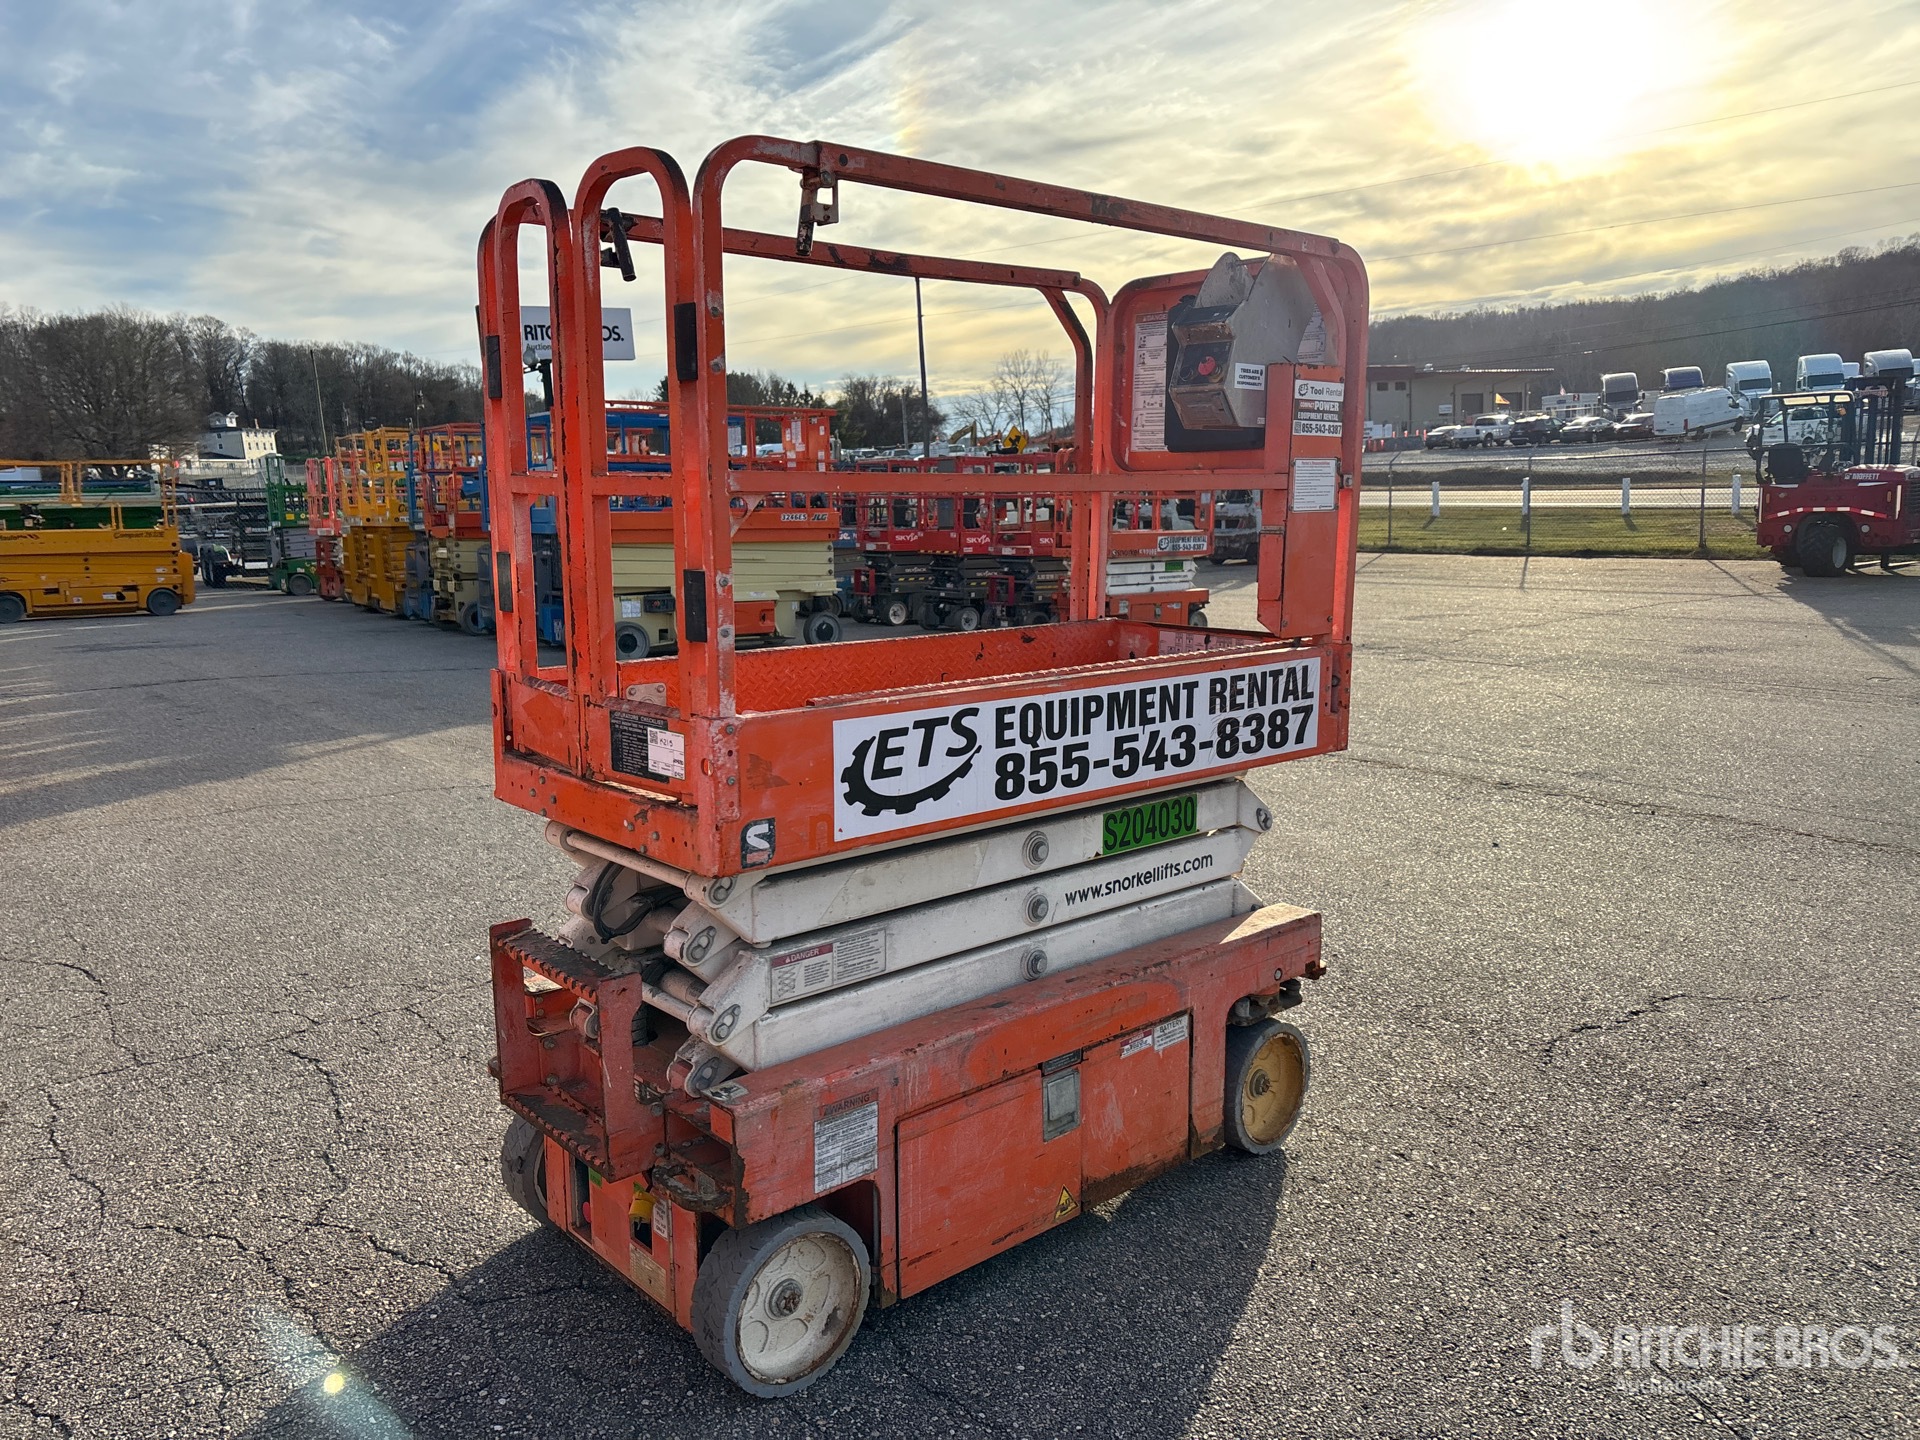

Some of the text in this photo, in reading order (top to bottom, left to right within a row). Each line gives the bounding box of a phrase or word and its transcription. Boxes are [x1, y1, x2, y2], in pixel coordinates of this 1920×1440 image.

[523, 324, 624, 341] RITC OS.
[526, 343, 551, 352] Auction
[1310, 386, 1342, 397] Tool Rental
[1314, 401, 1339, 411] POWER
[1297, 412, 1339, 421] EQUIPMENT RENTAL
[1301, 423, 1341, 434] 855-543-8387
[811, 513, 828, 521] JLG
[895, 533, 918, 542] SKYJA
[966, 534, 990, 545] SKYJA
[1169, 536, 1192, 544] EQUIPMENT
[994, 664, 1315, 750] EQUIPMENT RENTAL
[640, 716, 664, 725] CHECKLIST
[871, 706, 980, 780] ETS
[995, 704, 1314, 801] 855-543-8387
[1104, 796, 1197, 851] S204030
[1065, 854, 1213, 906] www.snorkellifts.com
[790, 948, 820, 962] DANGER
[1159, 1018, 1182, 1033] BATTERY
[829, 1093, 871, 1114] WARNING
